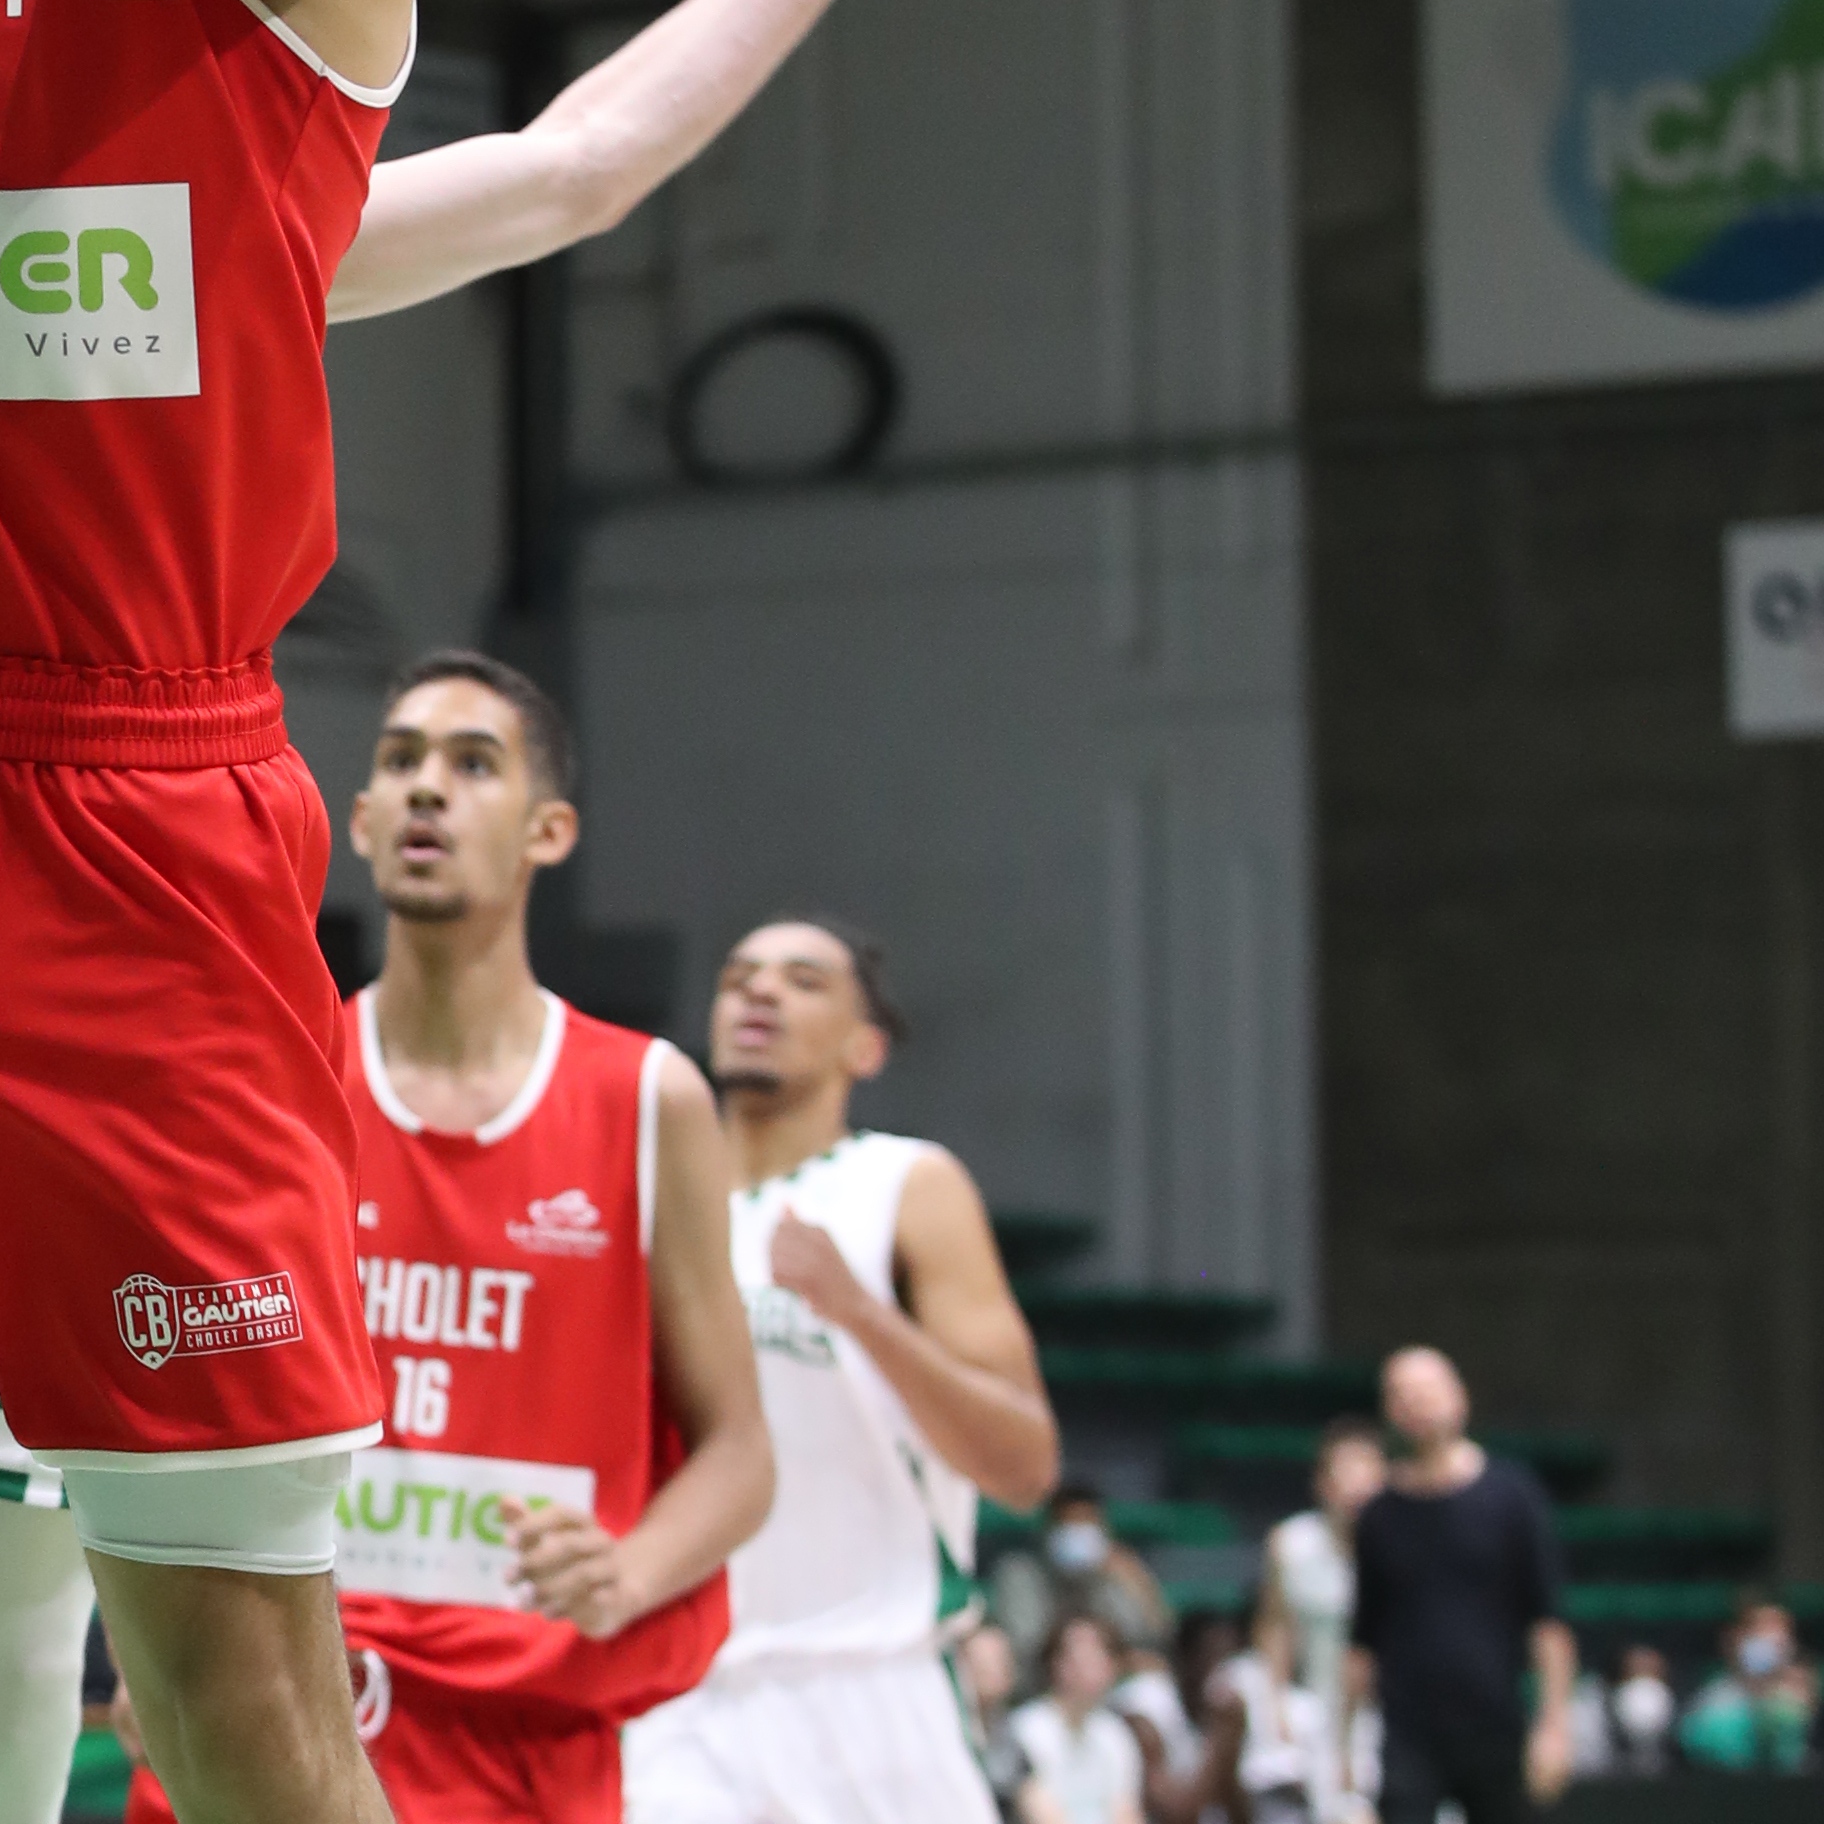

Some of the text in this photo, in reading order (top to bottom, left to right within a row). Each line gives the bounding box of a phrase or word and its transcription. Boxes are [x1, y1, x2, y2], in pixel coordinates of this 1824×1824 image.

[1588, 61, 1824, 191] ICA
[25, 331, 161, 357] Vivez
[123, 1294, 172, 1348] CB
[182, 1293, 292, 1327] GAUTIER
[357, 1255, 535, 1352] HOLET
[185, 1320, 295, 1348] CHOLET BASKET
[392, 1355, 452, 1438] 16
